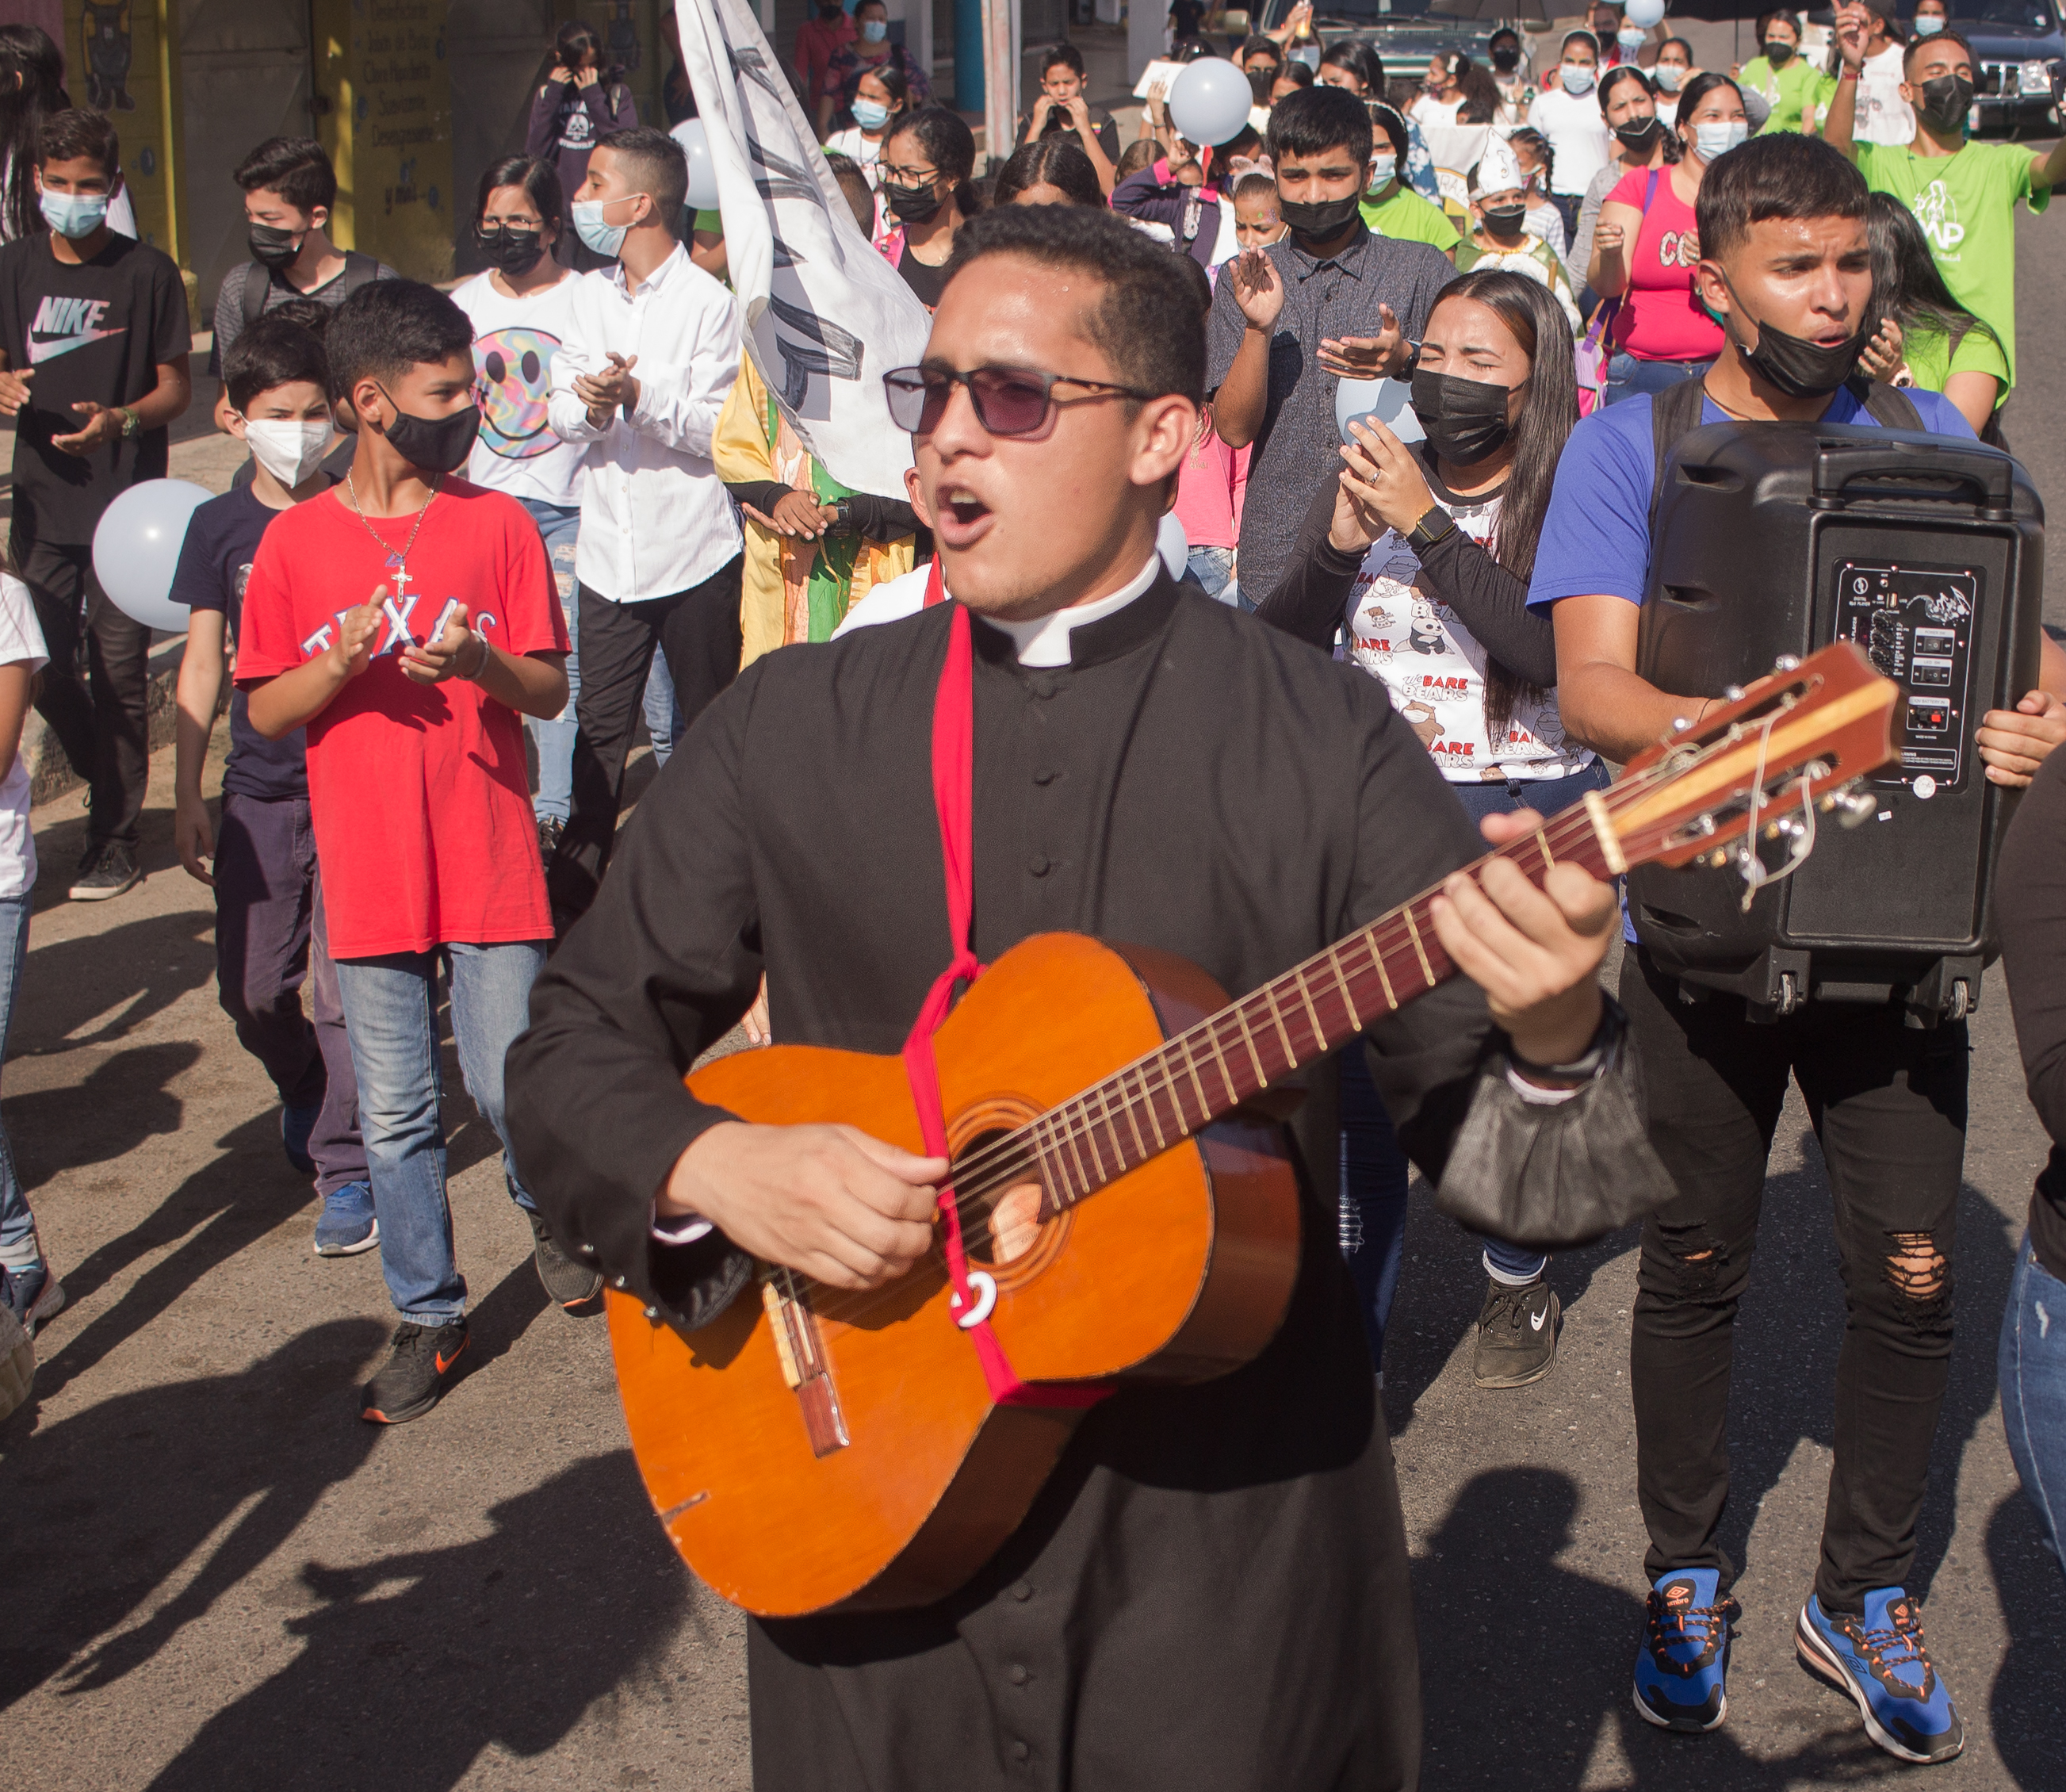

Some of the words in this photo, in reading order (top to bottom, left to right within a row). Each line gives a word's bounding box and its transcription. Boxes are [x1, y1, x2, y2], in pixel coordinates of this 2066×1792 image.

[32, 296, 110, 335] NIKE
[1423, 675, 1468, 689] BARE
[1402, 683, 1469, 702] BEARS
[1666, 1597, 1689, 1607] umbro
